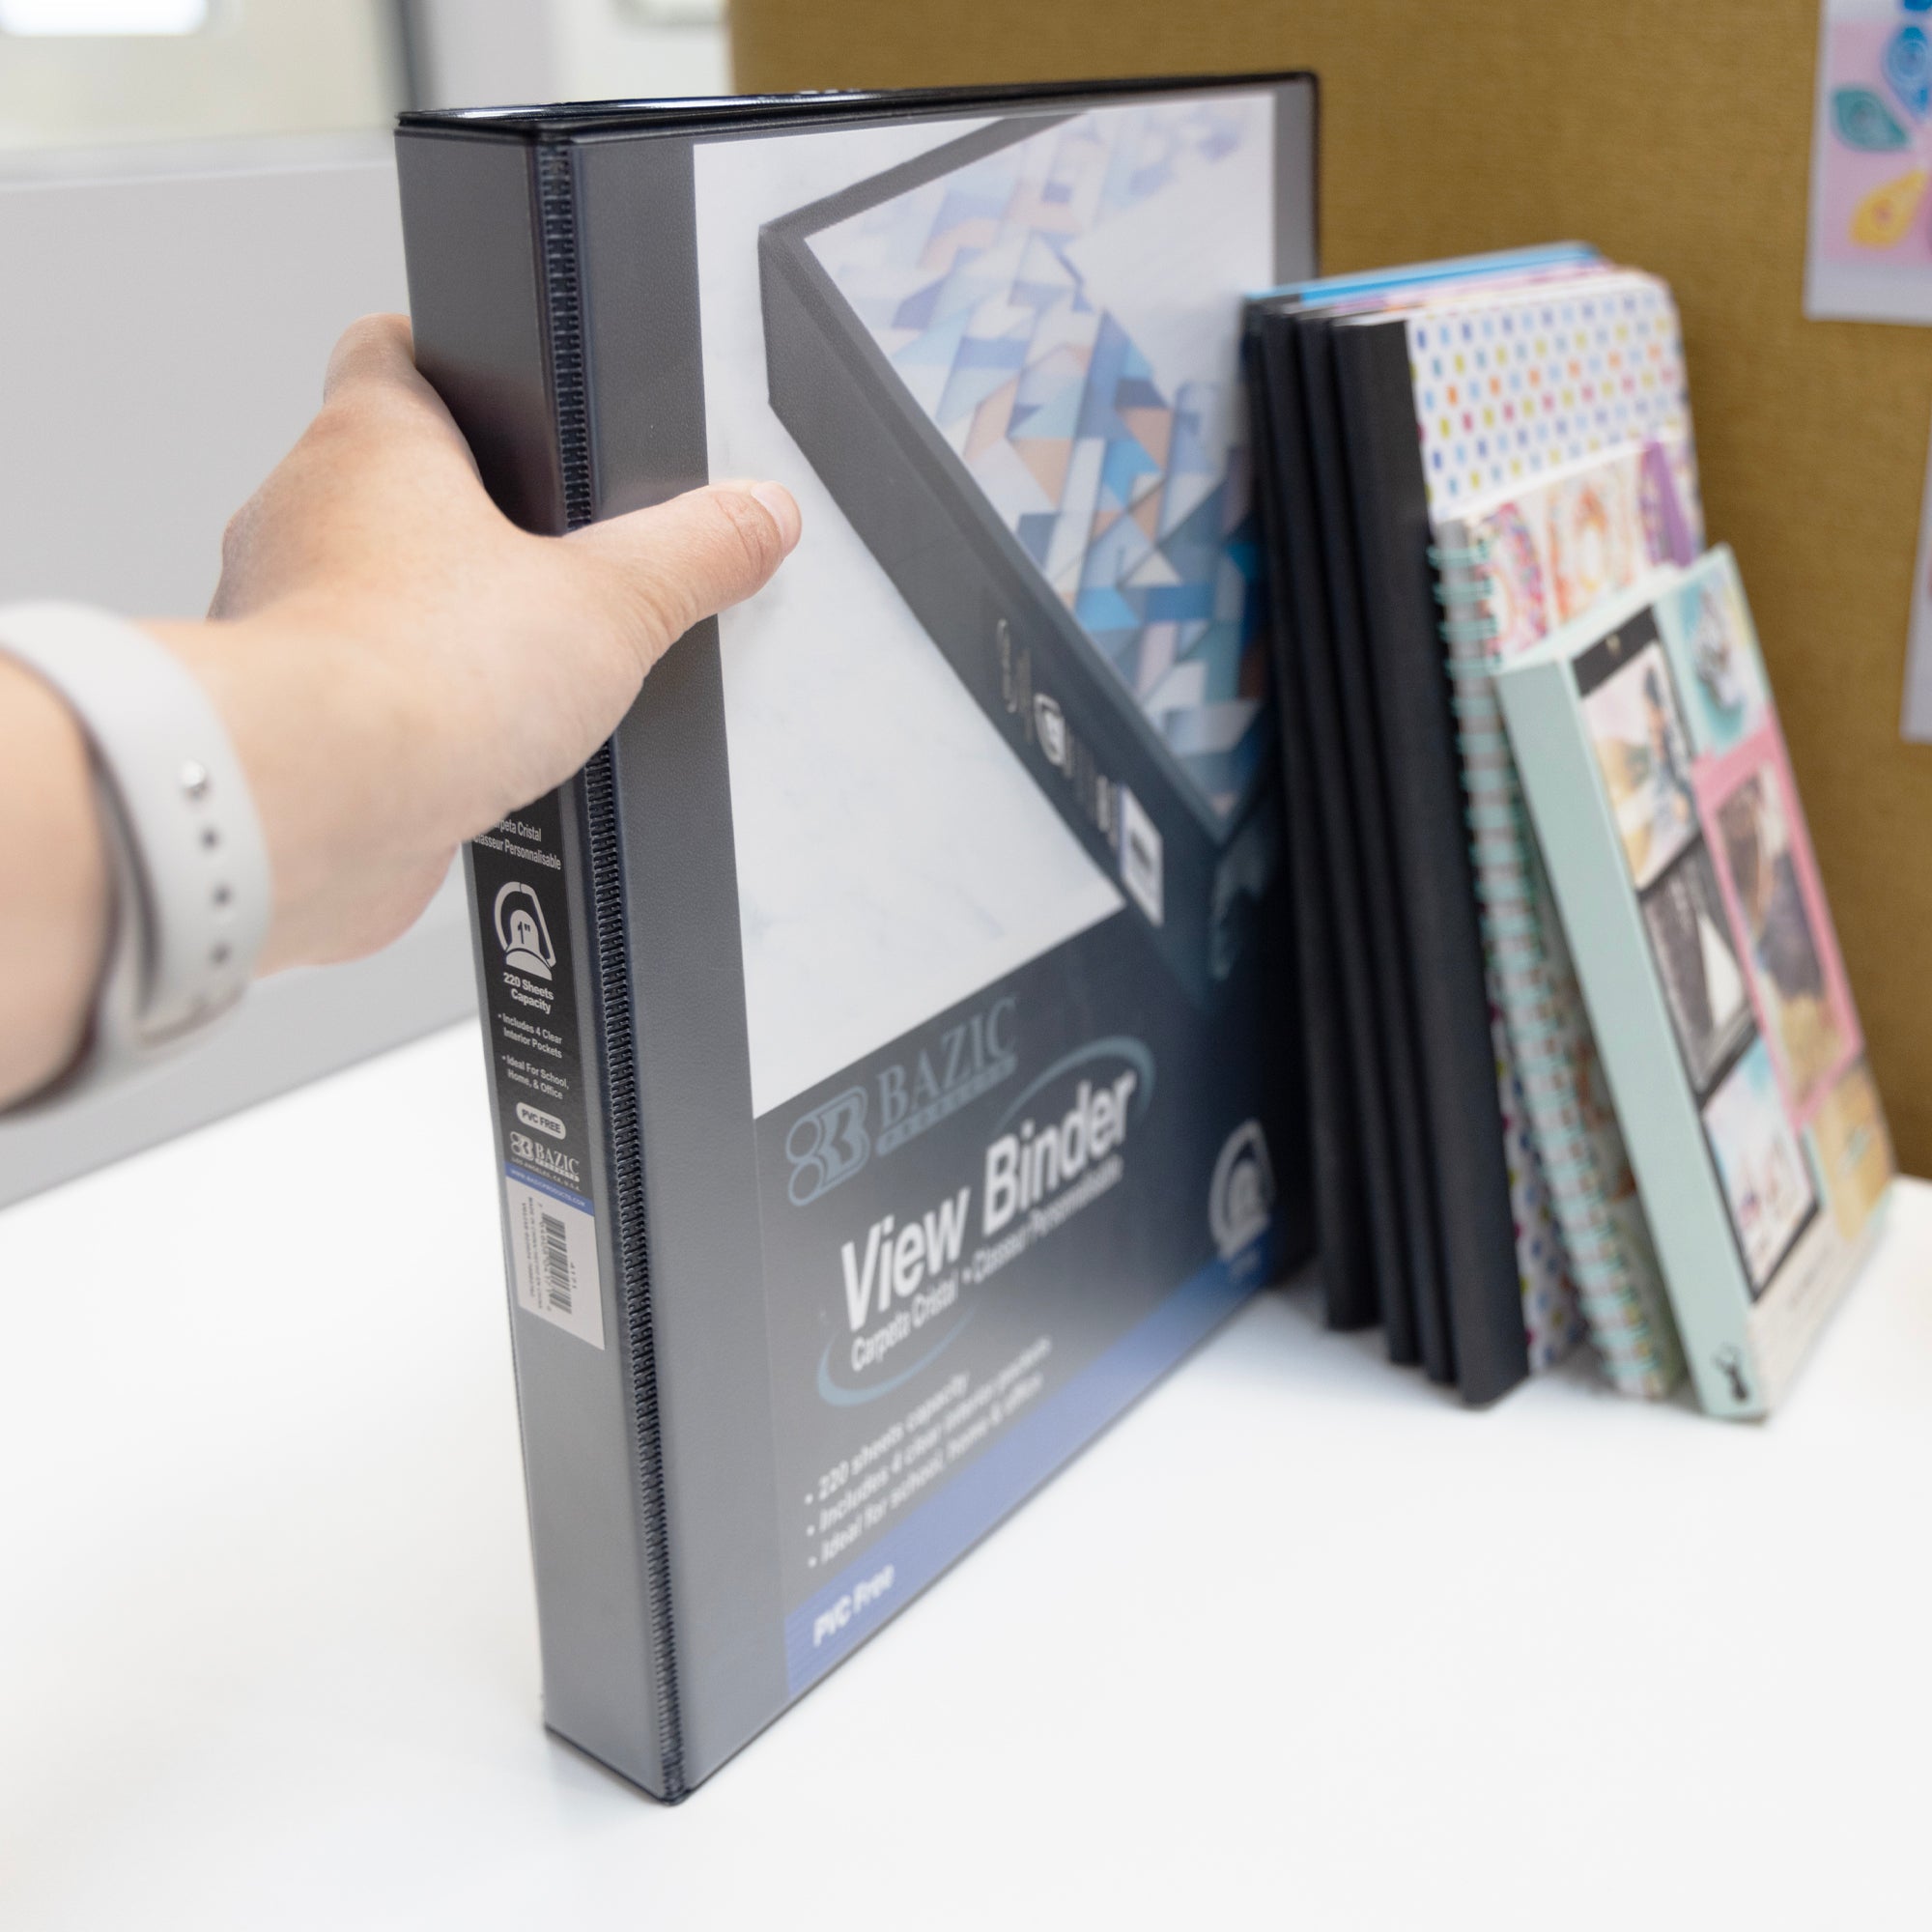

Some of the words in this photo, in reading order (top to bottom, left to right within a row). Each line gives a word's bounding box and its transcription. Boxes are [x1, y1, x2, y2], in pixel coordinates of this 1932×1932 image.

[518, 821, 541, 841] Cristal
[505, 838, 561, 869] Personnalisable
[503, 972, 521, 987] 220
[523, 979, 554, 1000] Sheets
[511, 988, 552, 1014] Capacity
[503, 1027, 530, 1046] Interior
[532, 1038, 562, 1059] Pockets
[542, 1029, 562, 1044] Clear
[526, 1064, 539, 1076] For
[876, 996, 1017, 1128] BAZIC
[541, 1083, 563, 1099] Office
[522, 1108, 538, 1123] PVC
[540, 1116, 561, 1134] FREE
[535, 1142, 581, 1177] BAZIC
[841, 1186, 971, 1333] View
[983, 1070, 1136, 1237] Binder
[851, 1309, 911, 1372] Carpeta
[819, 1460, 849, 1500] 220
[813, 1594, 852, 1647] PVC
